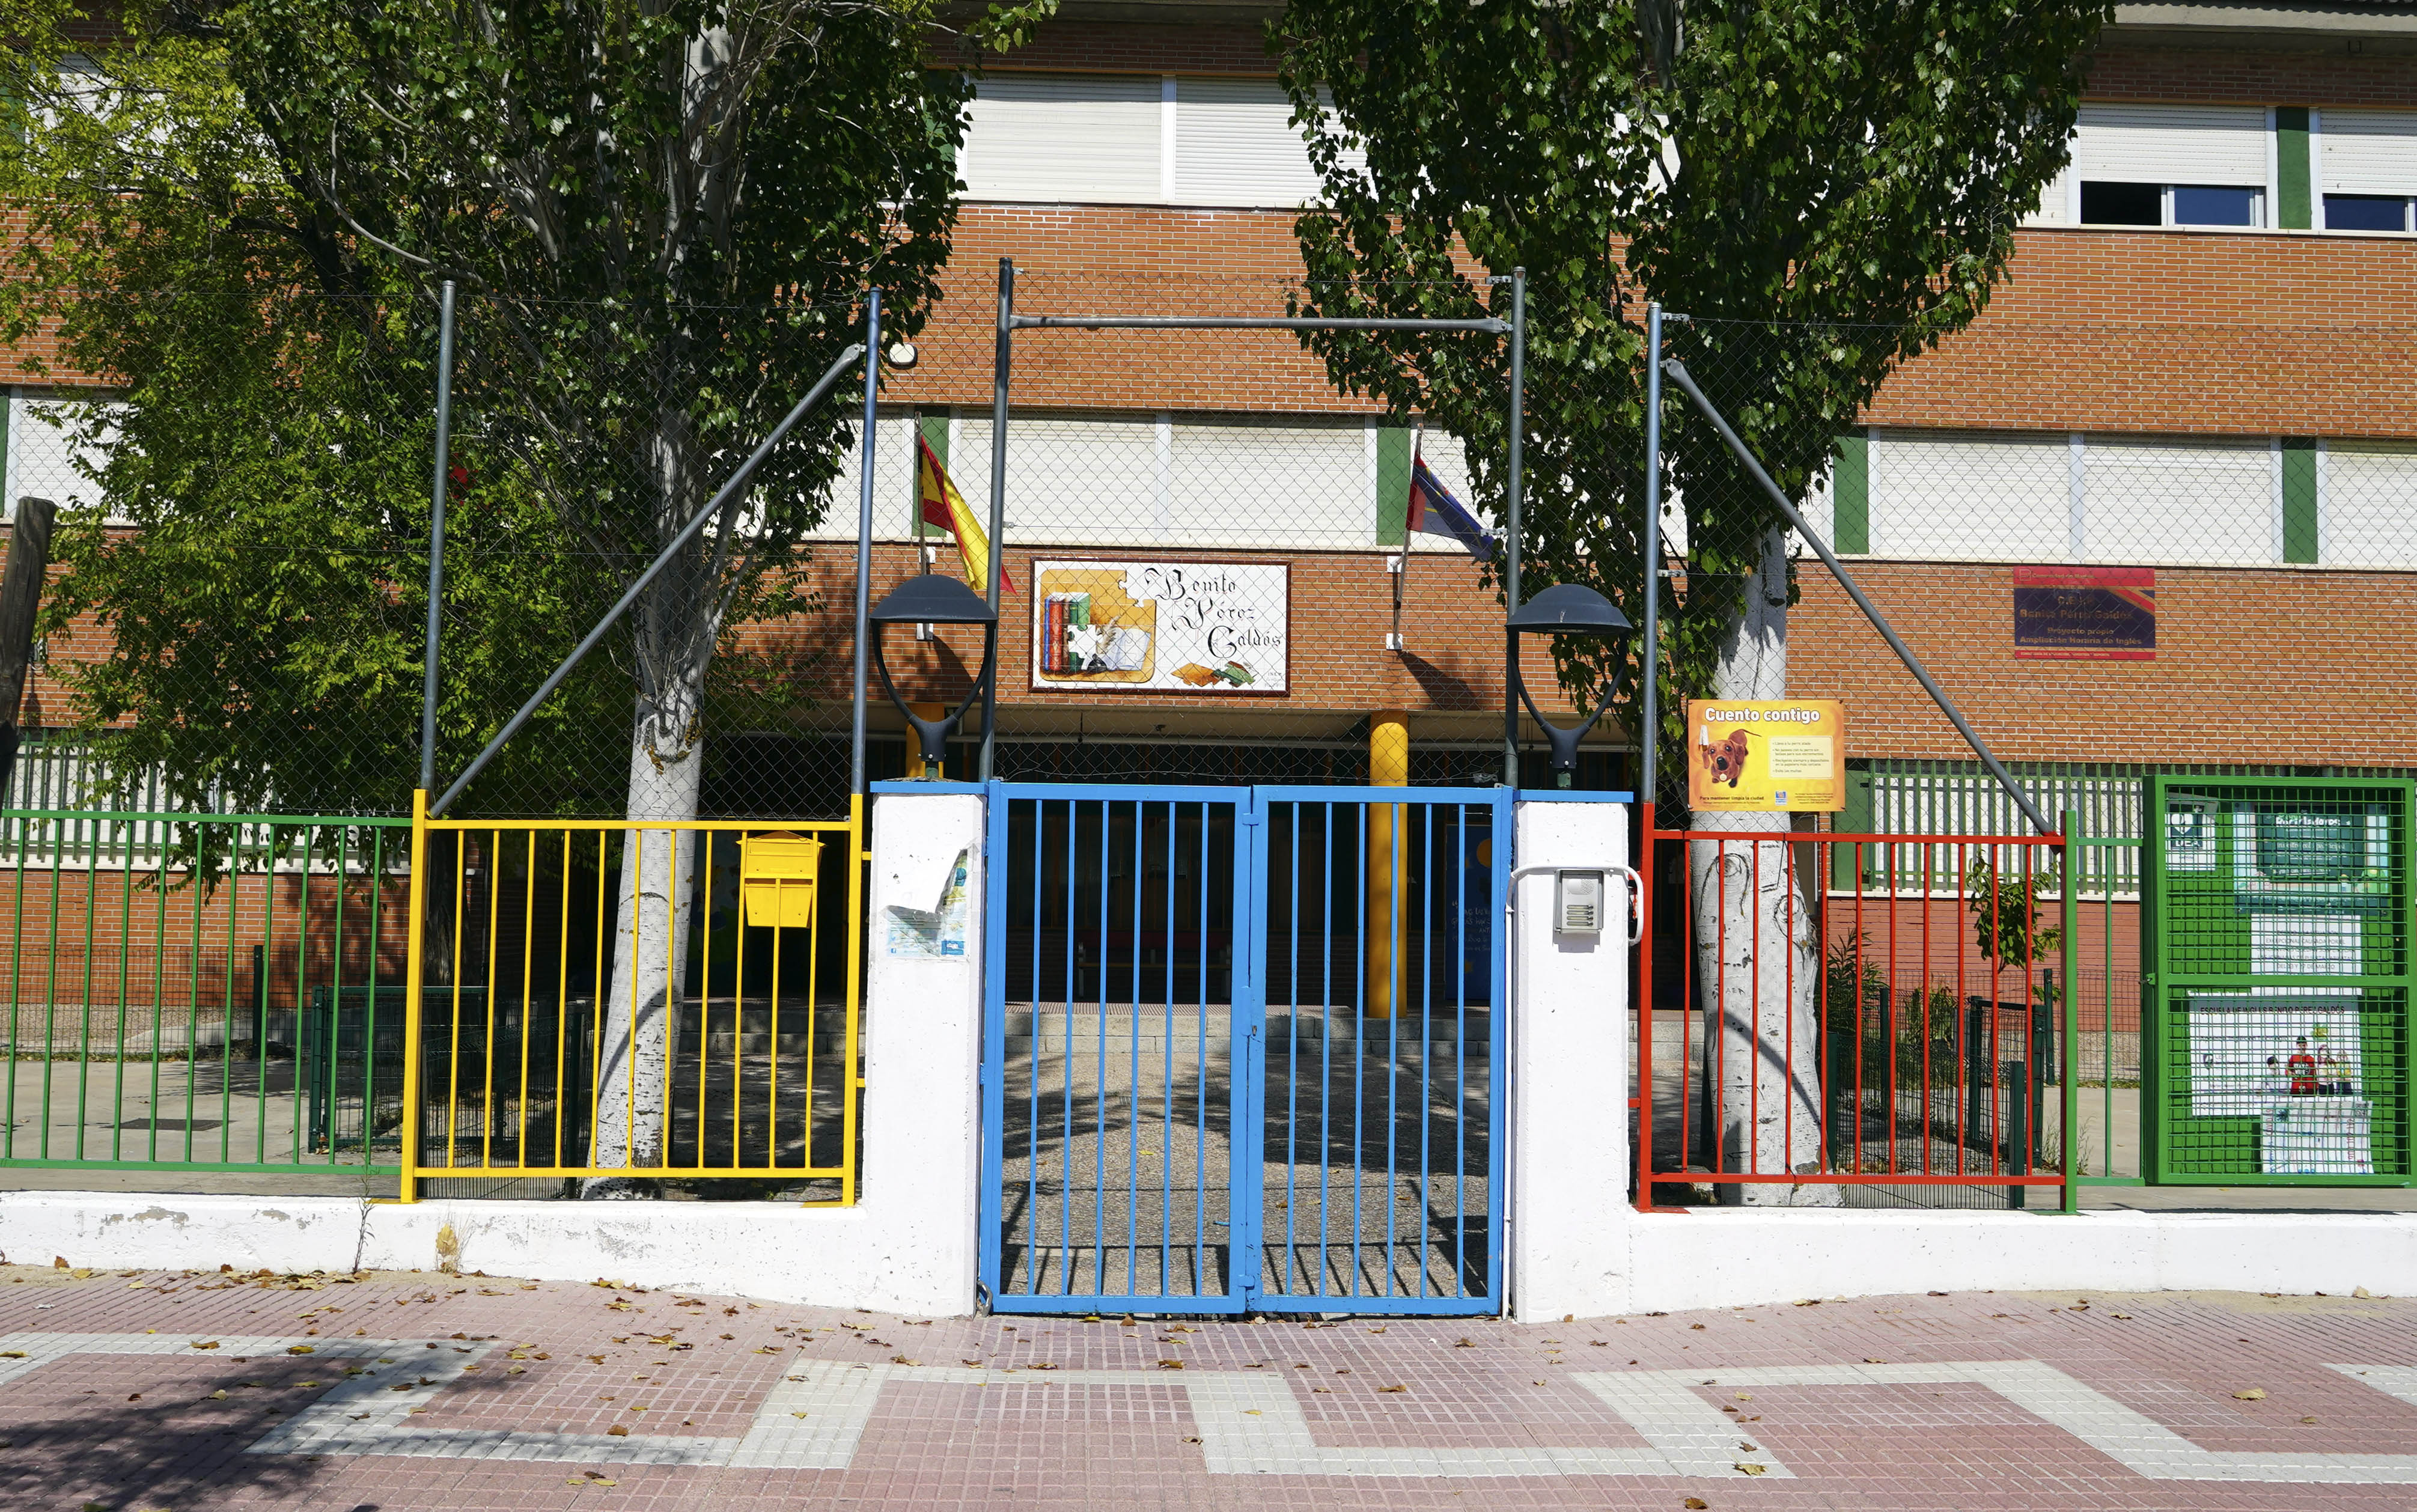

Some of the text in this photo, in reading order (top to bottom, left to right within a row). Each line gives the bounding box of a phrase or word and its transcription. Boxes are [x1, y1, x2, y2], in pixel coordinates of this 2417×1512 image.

[1144, 568, 1236, 600] Benito
[1171, 597, 1255, 630] Pérez
[1208, 625, 1281, 658] Galdós
[1705, 707, 1820, 724] Cuento contigo
